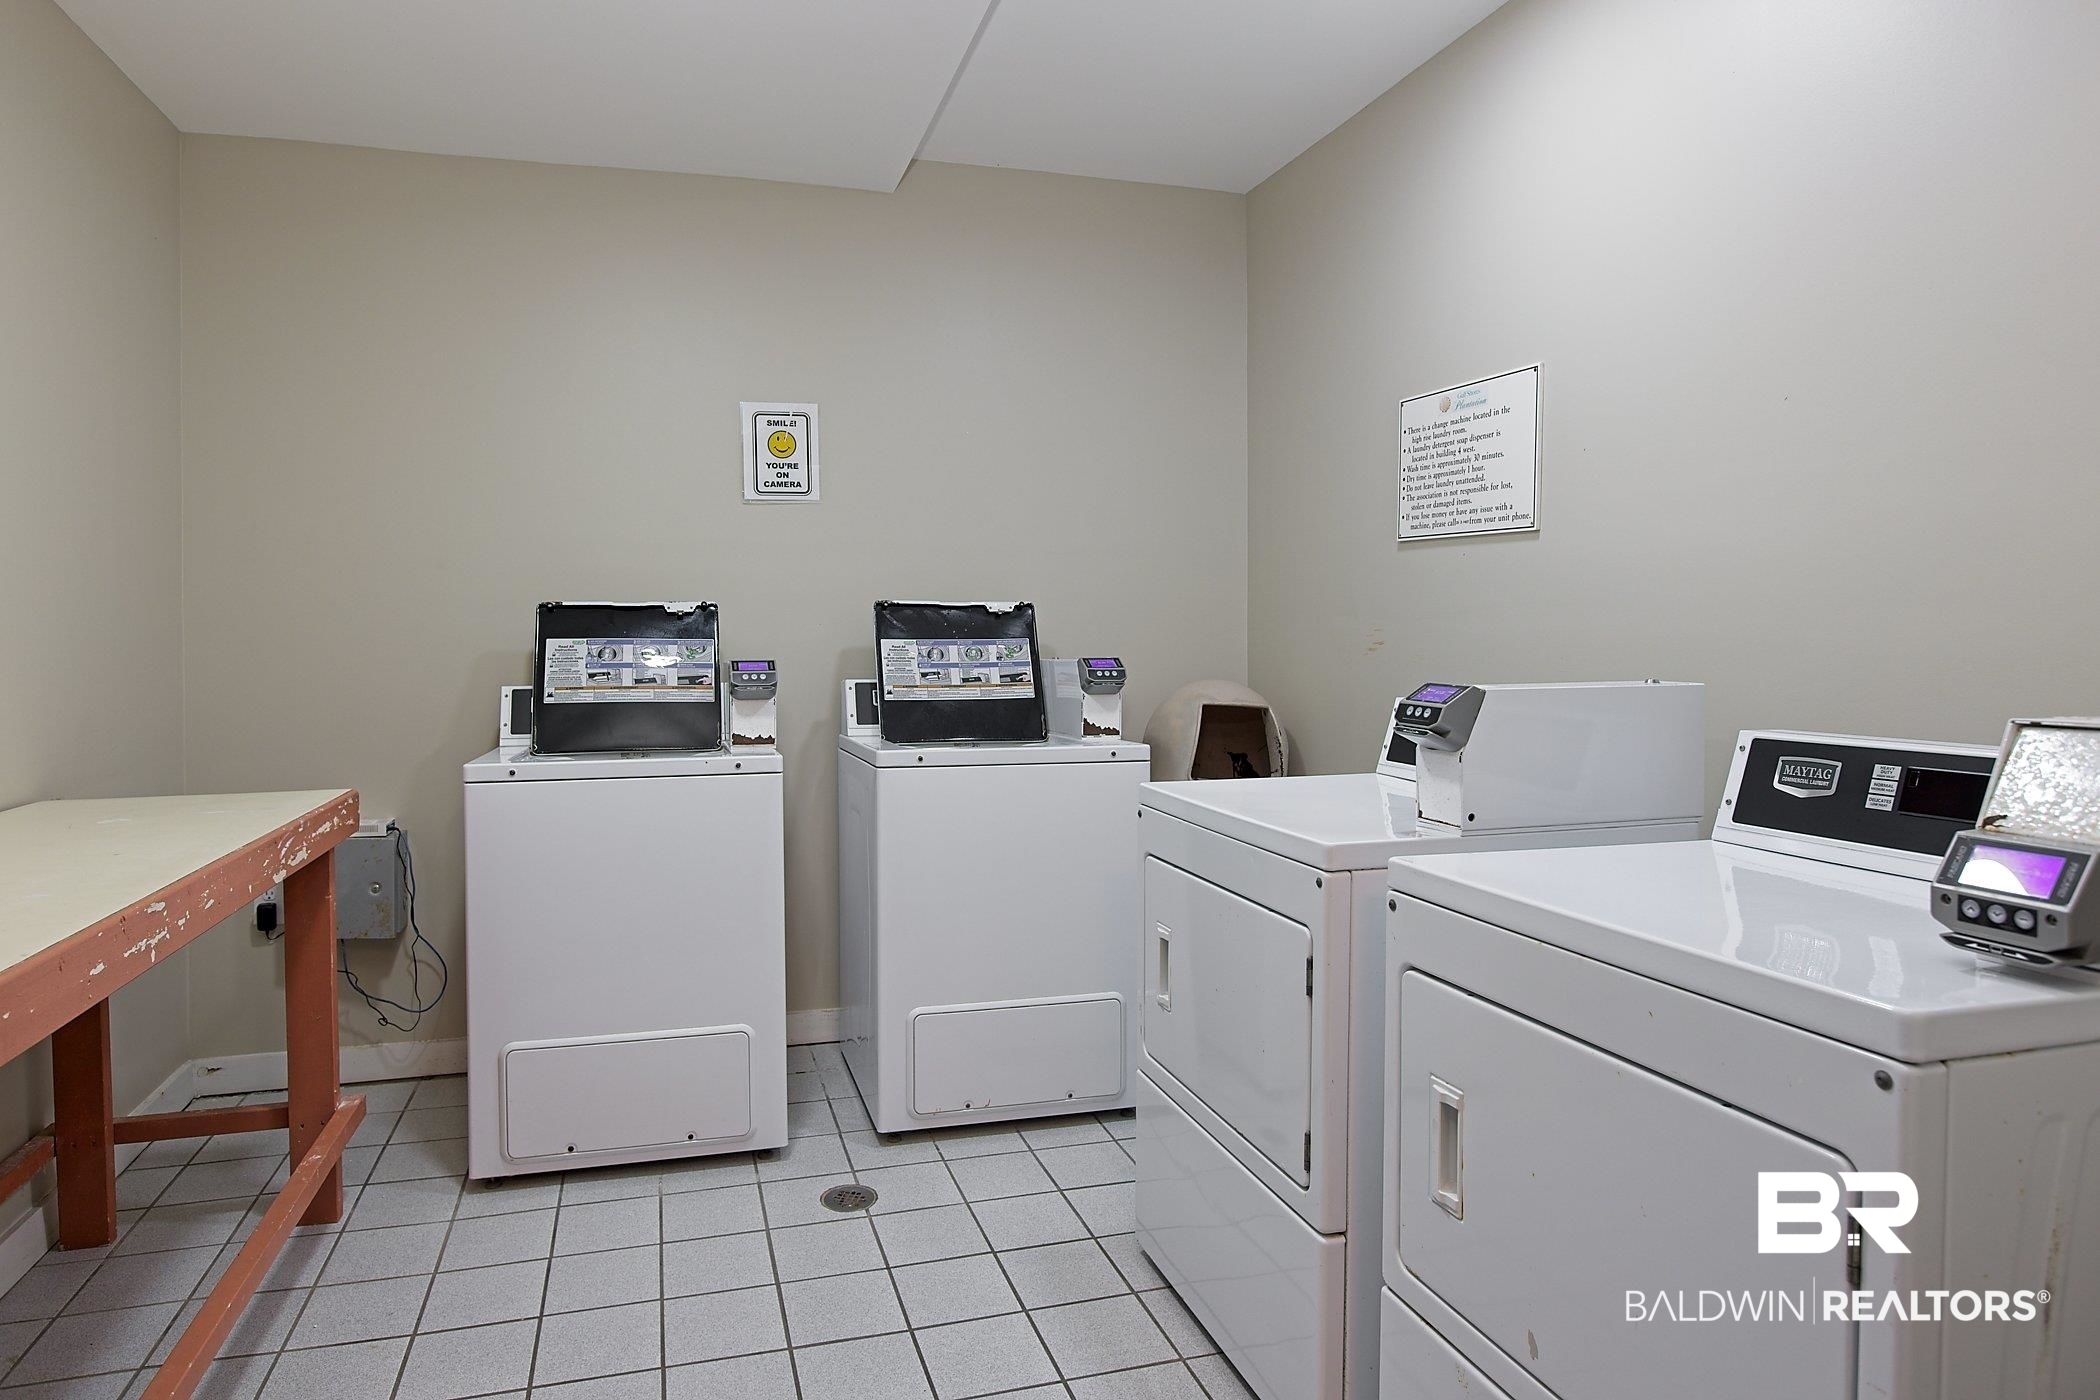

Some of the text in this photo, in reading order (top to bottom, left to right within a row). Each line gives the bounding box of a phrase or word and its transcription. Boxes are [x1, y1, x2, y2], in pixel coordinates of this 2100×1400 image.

[1454, 398, 1487, 410] Plantation
[1408, 427, 1421, 435] There
[1450, 416, 1471, 425] machine
[1473, 409, 1491, 420] located
[1494, 408, 1499, 416] in
[1501, 406, 1510, 414] the
[1412, 435, 1422, 444] high
[1433, 430, 1450, 440] laundry
[1413, 444, 1430, 453] laundry
[1432, 440, 1455, 450] detergent
[1470, 432, 1494, 442] dispenser
[1407, 464, 1419, 472] Wash
[1437, 455, 1471, 469] approximately
[1474, 453, 1480, 462] 30
[1482, 452, 1504, 460] minutes.
[1412, 453, 1428, 462] located
[1436, 448, 1456, 458] building
[766, 462, 799, 470] YOU'RE
[1407, 475, 1415, 483] Dry
[1433, 466, 1466, 479] approximately
[1472, 464, 1485, 472] hour.
[1424, 482, 1434, 490] leave
[1436, 478, 1454, 488] laundry
[1456, 474, 1485, 485] unattended.
[1407, 494, 1415, 502] The
[1416, 491, 1443, 500] association
[1460, 483, 1489, 496] responsible
[1491, 482, 1499, 490] for
[1500, 481, 1513, 490] lost,
[1421, 511, 1430, 519] lose
[1495, 502, 1508, 511] with
[1433, 498, 1455, 508] damaged
[1456, 498, 1472, 506] items.
[1410, 522, 1431, 530] machine,
[1432, 520, 1446, 529] please
[1447, 518, 1456, 526] call
[1469, 516, 1483, 524] from
[1484, 515, 1496, 523] your
[1498, 513, 1510, 521] unit
[1512, 512, 1531, 522] phone.
[1782, 776, 1809, 784] COMMERCIAL
[1783, 766, 1832, 780] MAYTAG
